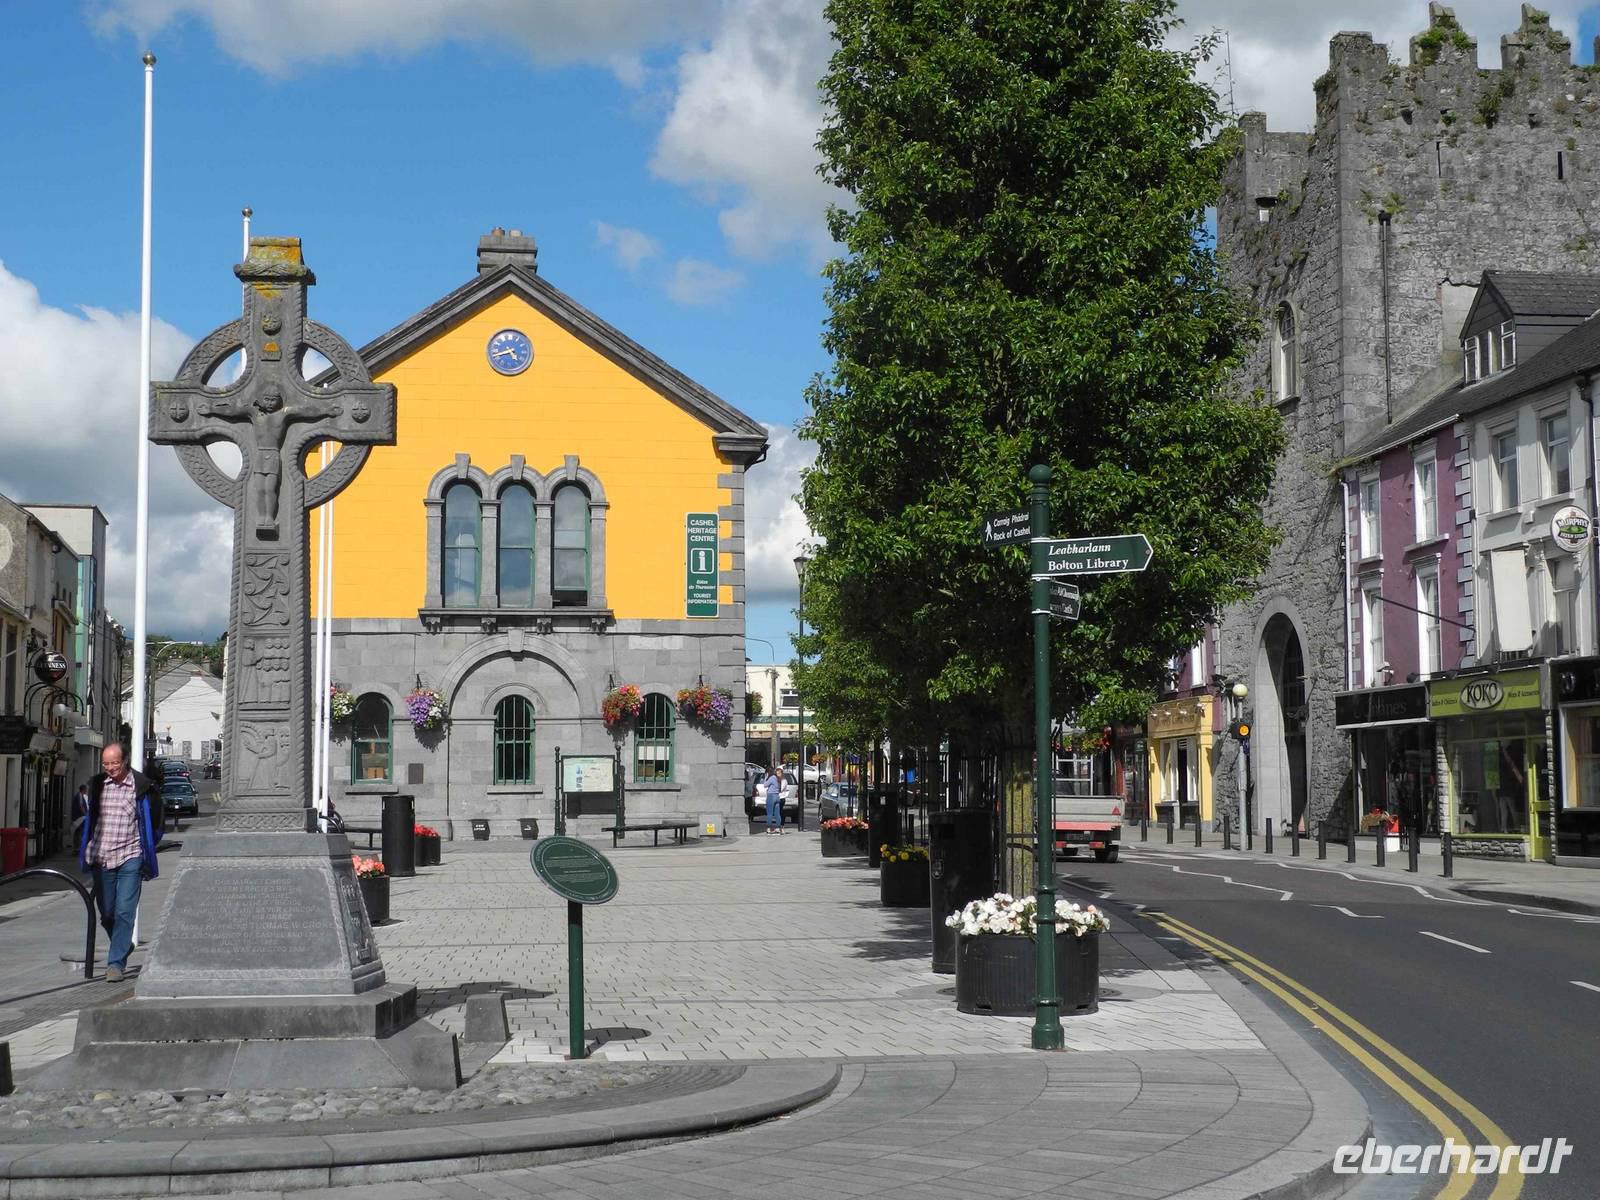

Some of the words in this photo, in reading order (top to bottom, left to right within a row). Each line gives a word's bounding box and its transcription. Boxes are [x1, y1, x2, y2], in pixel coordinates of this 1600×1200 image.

[993, 532, 1006, 541] Rock
[1006, 529, 1013, 539] of
[1013, 525, 1031, 537] Cashel
[1048, 543, 1111, 556] Leabharlann
[1047, 560, 1084, 572] Bolton
[1086, 558, 1129, 570] Library
[1467, 683, 1497, 707] KOKO
